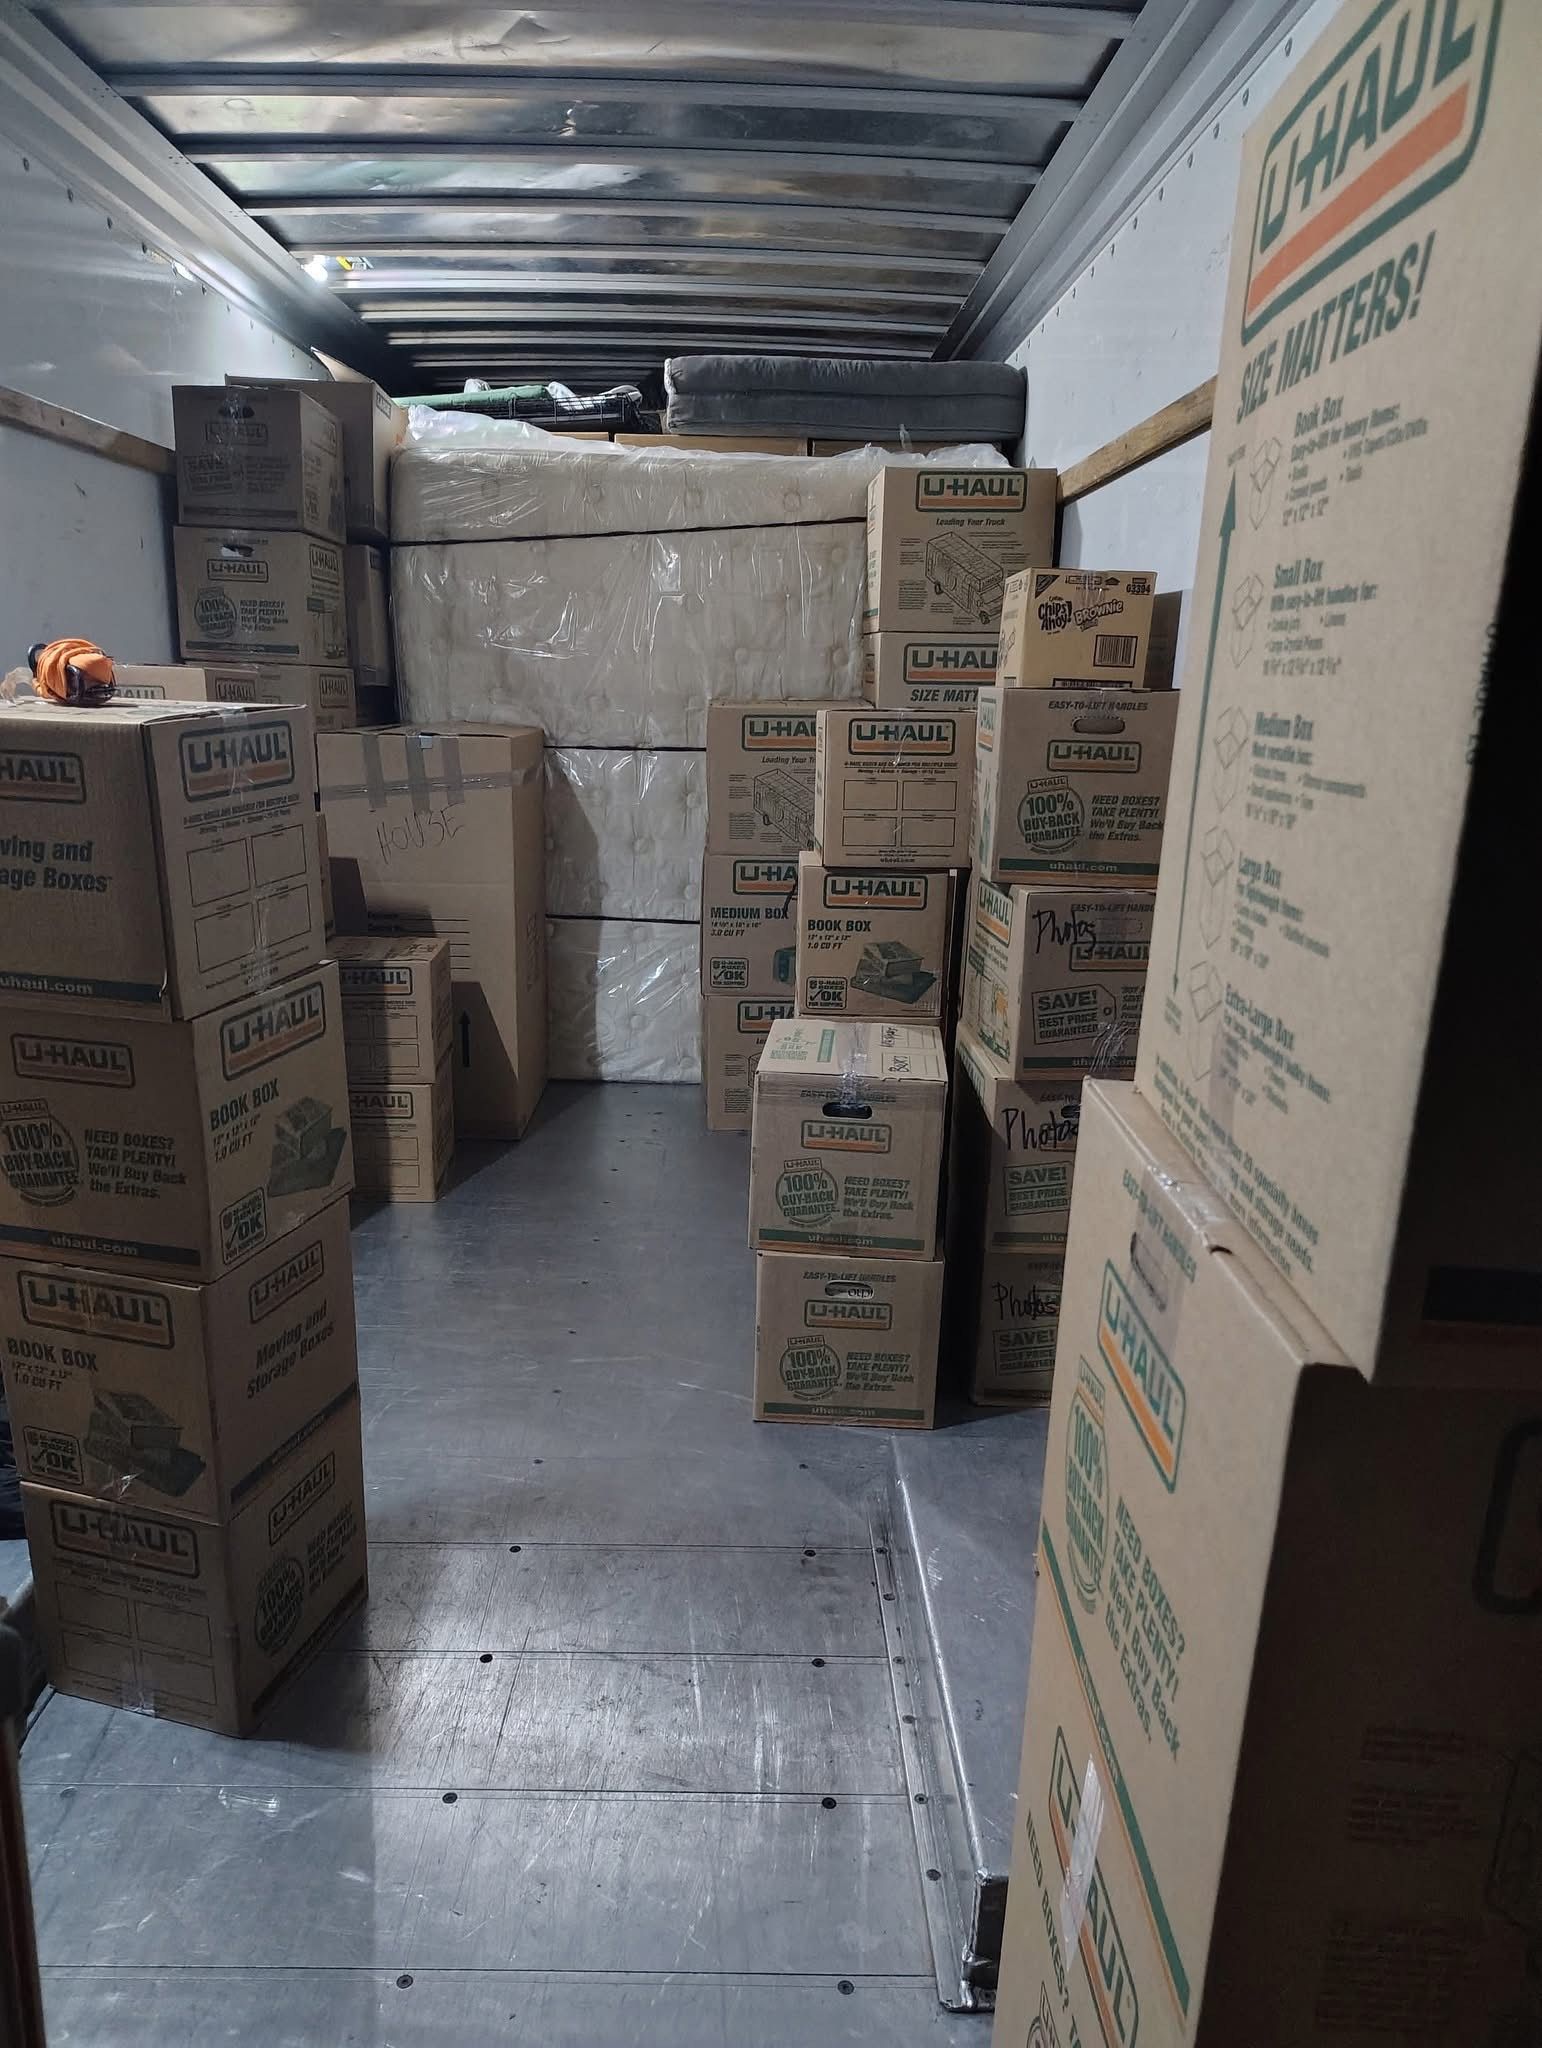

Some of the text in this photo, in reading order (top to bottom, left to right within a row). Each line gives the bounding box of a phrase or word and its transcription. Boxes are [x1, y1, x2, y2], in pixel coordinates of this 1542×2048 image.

[1260, 0, 1477, 254] U-HAUL
[1236, 229, 1437, 424] SIZE MATTERS!
[1321, 395, 1345, 425] Box
[924, 478, 1021, 497] U-HAUL
[211, 562, 264, 575] U-HAUL
[1274, 557, 1324, 589] Small Box
[910, 689, 940, 702] SIZE
[750, 720, 816, 737] U-HA
[857, 725, 949, 741] U-HAUL
[188, 731, 289, 774] U-HAUL
[1053, 744, 1136, 761] U-HAUL
[1027, 792, 1075, 816] 100%
[376, 803, 467, 865] HOUSE
[52, 840, 93, 863] and
[1050, 861, 1118, 873] uhaul.com
[830, 880, 921, 897] U-HAUL
[711, 907, 789, 920] MEDIUM BOX
[979, 885, 1010, 926] U-HAUL
[808, 920, 872, 932] BOOK BOX
[0, 973, 94, 997] uhaul.com
[821, 990, 843, 1001] OK
[1038, 988, 1098, 1011] SAVE!
[228, 993, 320, 1053] U-HAUL
[1038, 1016, 1065, 1029] BEST
[21, 1041, 128, 1072] U-HAUL
[210, 1078, 281, 1132] BOOK BOX
[2, 1123, 63, 1151] 100%
[84, 1128, 175, 1151] NEED BOXES?
[808, 1125, 887, 1142] U-HAUL
[86, 1146, 177, 1168] TAKE PLENTY!
[784, 1172, 828, 1193] 100%
[1008, 1166, 1067, 1186] SAVE!
[237, 1211, 263, 1240] OK
[51, 1235, 138, 1257] uhaul.com
[254, 1250, 320, 1306] U-HAUL
[811, 1304, 888, 1320] U-HAUL
[256, 1298, 328, 1371] Moving and
[7, 1337, 55, 1363] BOOK
[62, 1348, 99, 1372] BOX
[788, 1349, 831, 1369] 100%
[1105, 1279, 1175, 1445] U-HAUL
[272, 1462, 330, 1528] U-HAUL
[60, 1508, 189, 1557] U-HAUL
[1115, 1496, 1185, 1661] NEED BOXES?
[1113, 1531, 1179, 1703] TAKE PLENTY!
[1026, 1808, 1070, 2014] NEED BOXES?
